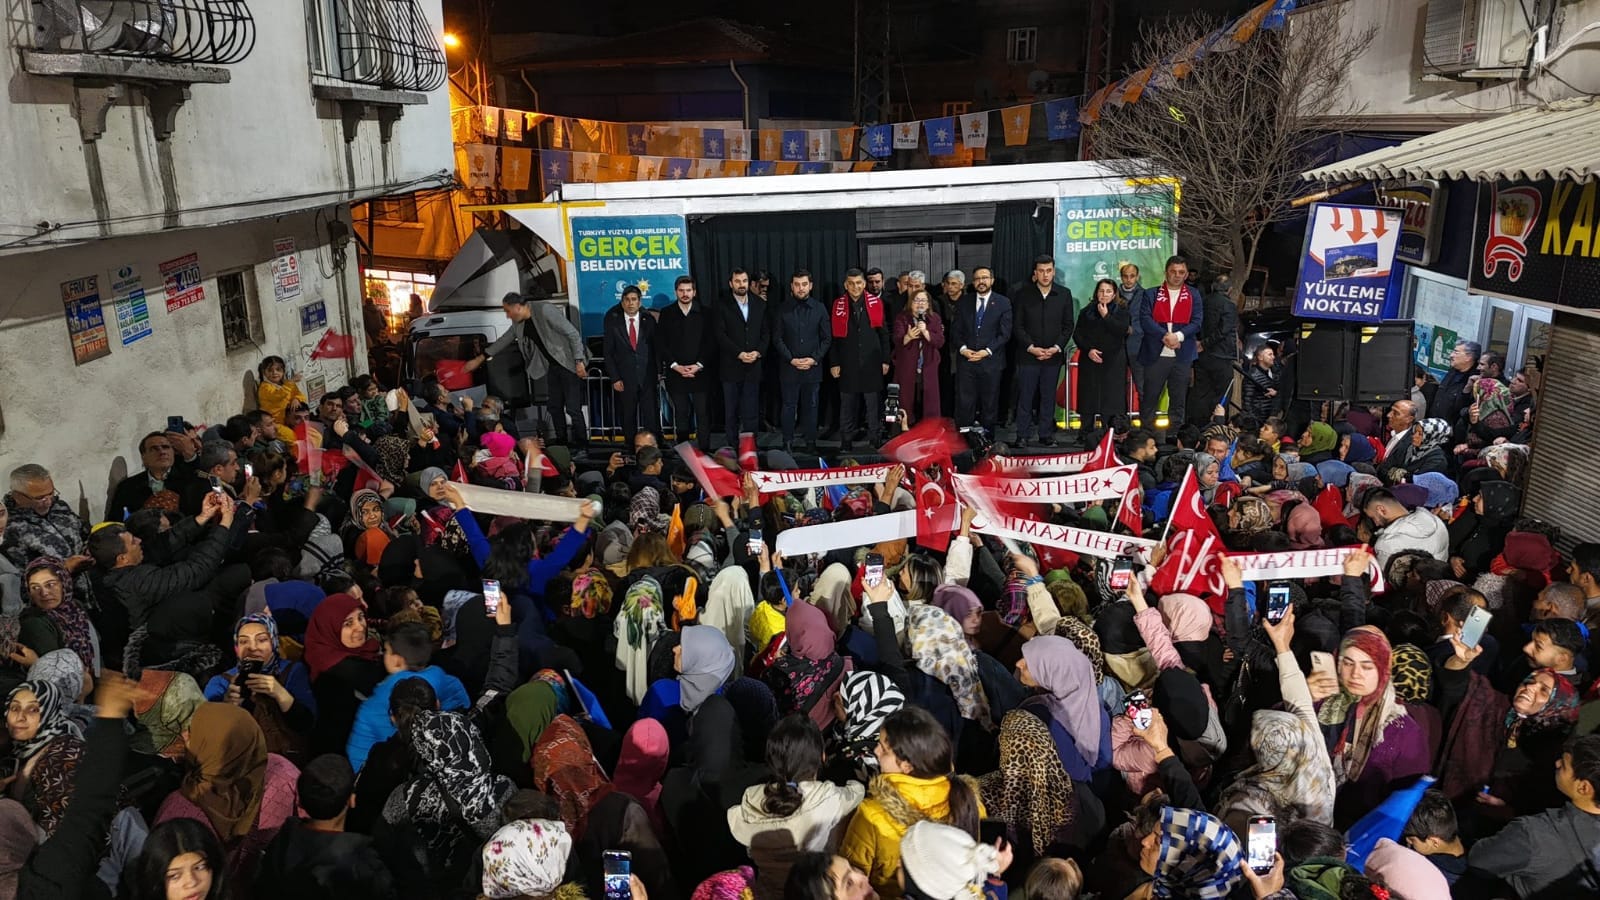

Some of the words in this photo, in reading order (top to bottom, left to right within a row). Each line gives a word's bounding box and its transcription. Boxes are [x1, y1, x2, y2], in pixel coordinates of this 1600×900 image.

[1067, 218, 1162, 240] GERÇEK
[1540, 179, 1600, 258] KA
[579, 234, 682, 258] GERÇEK
[1304, 280, 1386, 301] YÜKLEME
[1303, 298, 1380, 316] NOKTASI
